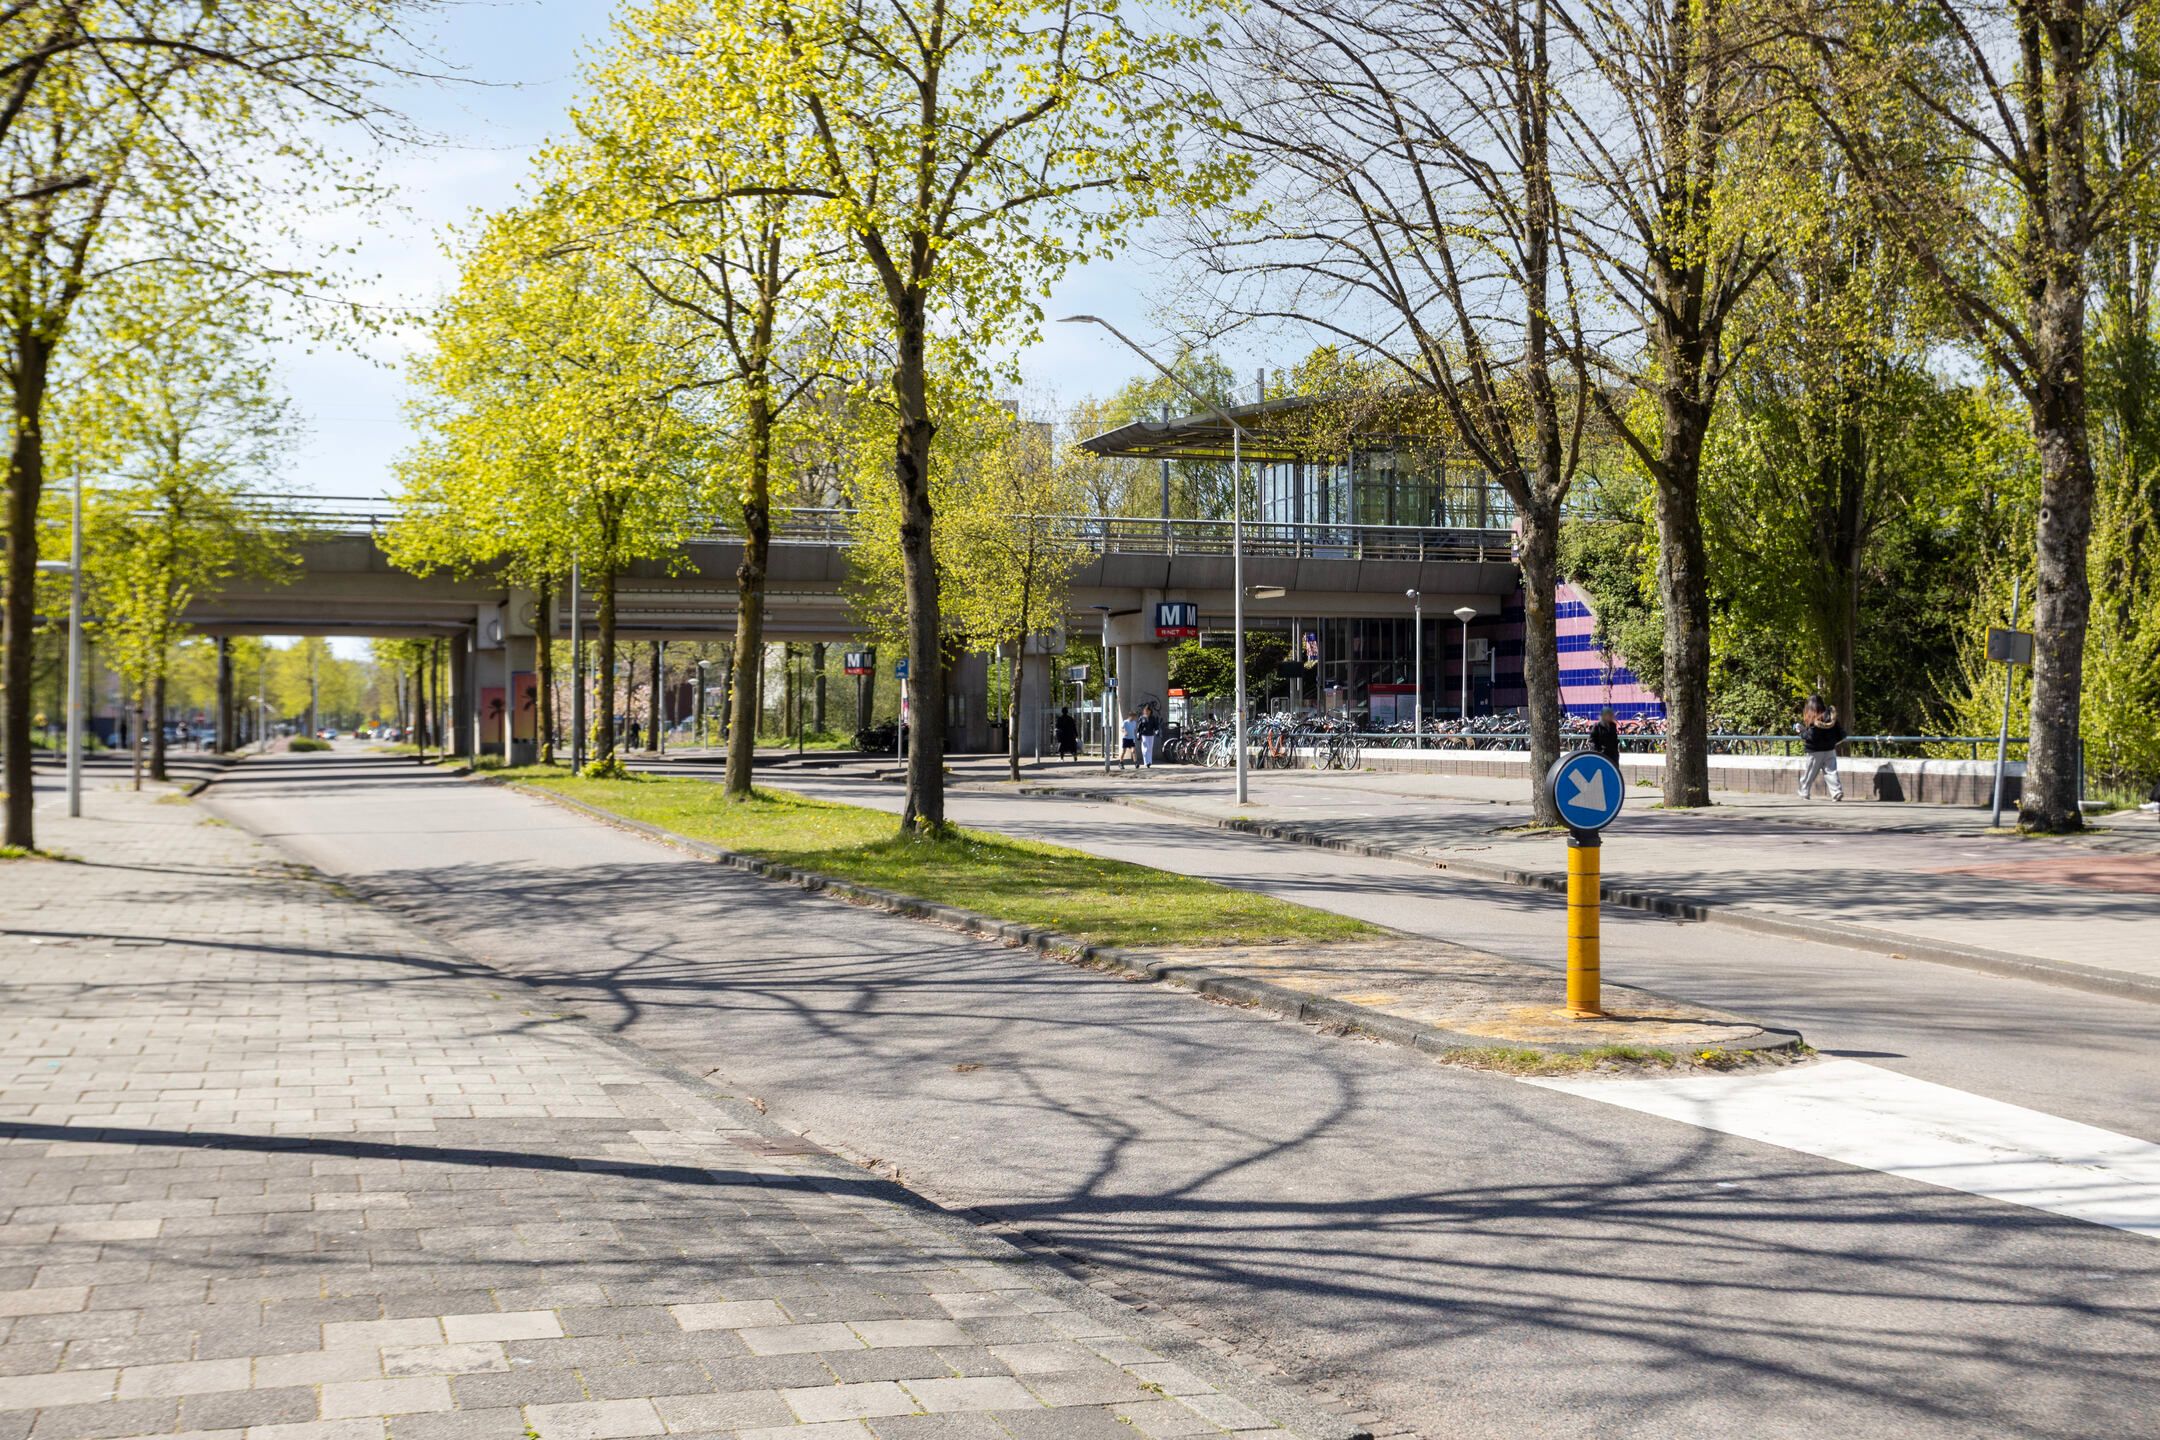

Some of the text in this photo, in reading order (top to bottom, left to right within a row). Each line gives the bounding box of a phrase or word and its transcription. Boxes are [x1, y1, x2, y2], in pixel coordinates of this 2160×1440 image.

[1161, 605, 1180, 626] M
[1187, 605, 1196, 626] M
[847, 653, 860, 667] M
[864, 653, 872, 667] M
[898, 660, 906, 670] P
